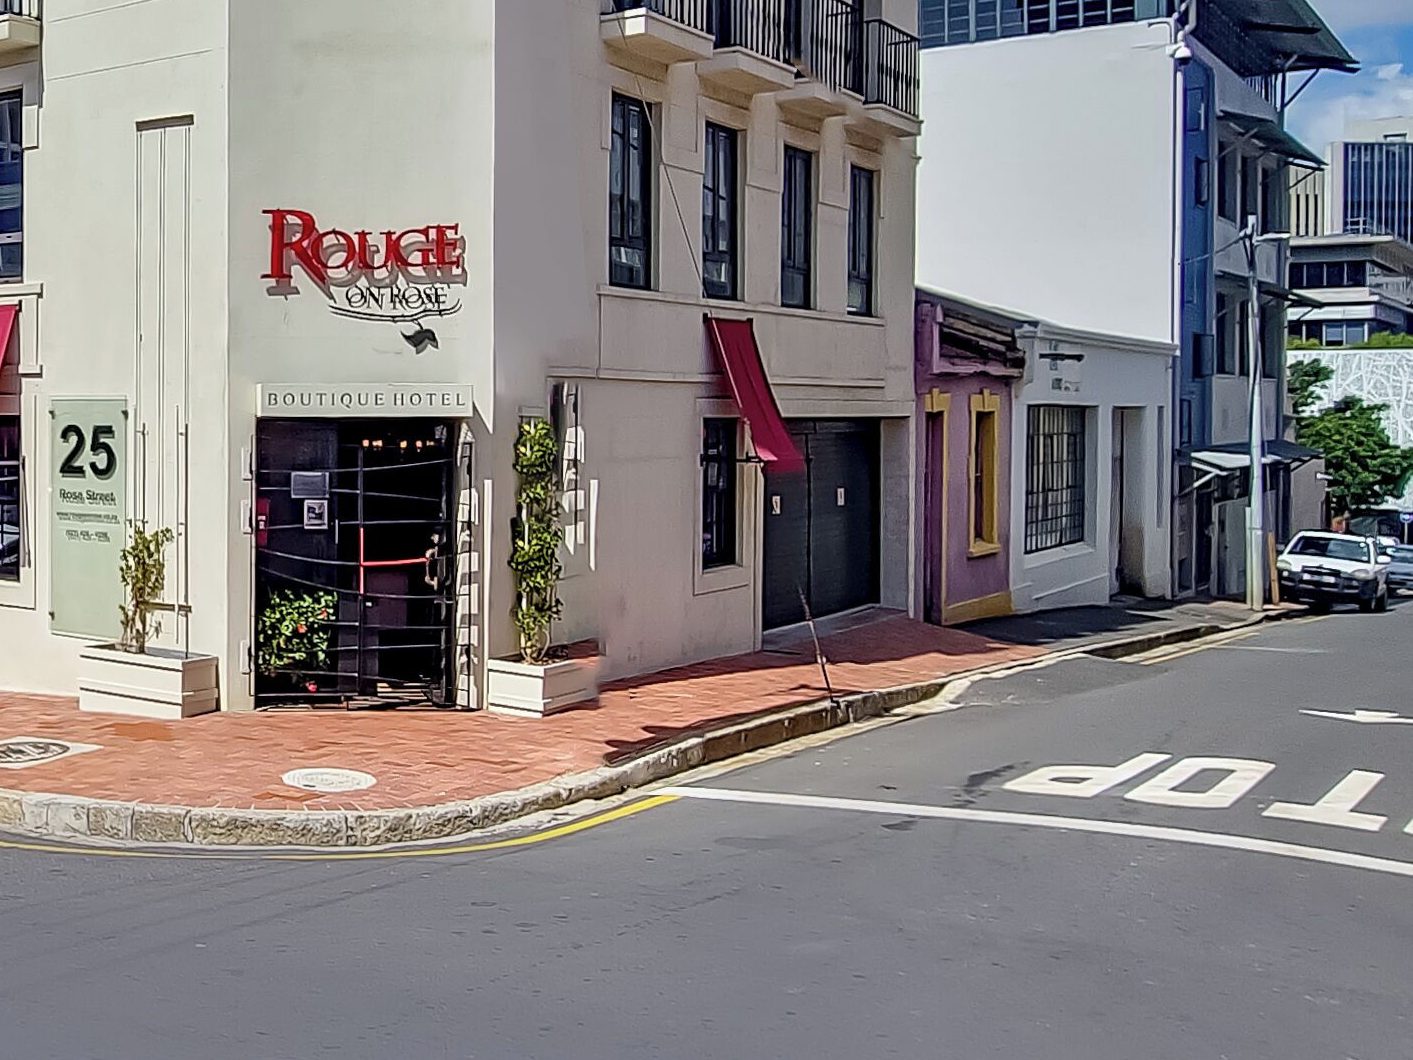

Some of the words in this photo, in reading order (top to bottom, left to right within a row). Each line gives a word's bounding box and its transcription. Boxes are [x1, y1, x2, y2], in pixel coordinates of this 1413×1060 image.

[345, 286, 382, 305] ON
[390, 286, 447, 306] ROSE
[267, 392, 386, 409] BOUTIQUE
[393, 392, 467, 407] HOTEL
[59, 424, 118, 478] 25
[59, 488, 84, 501] Rose
[1003, 752, 1413, 835] TOP
